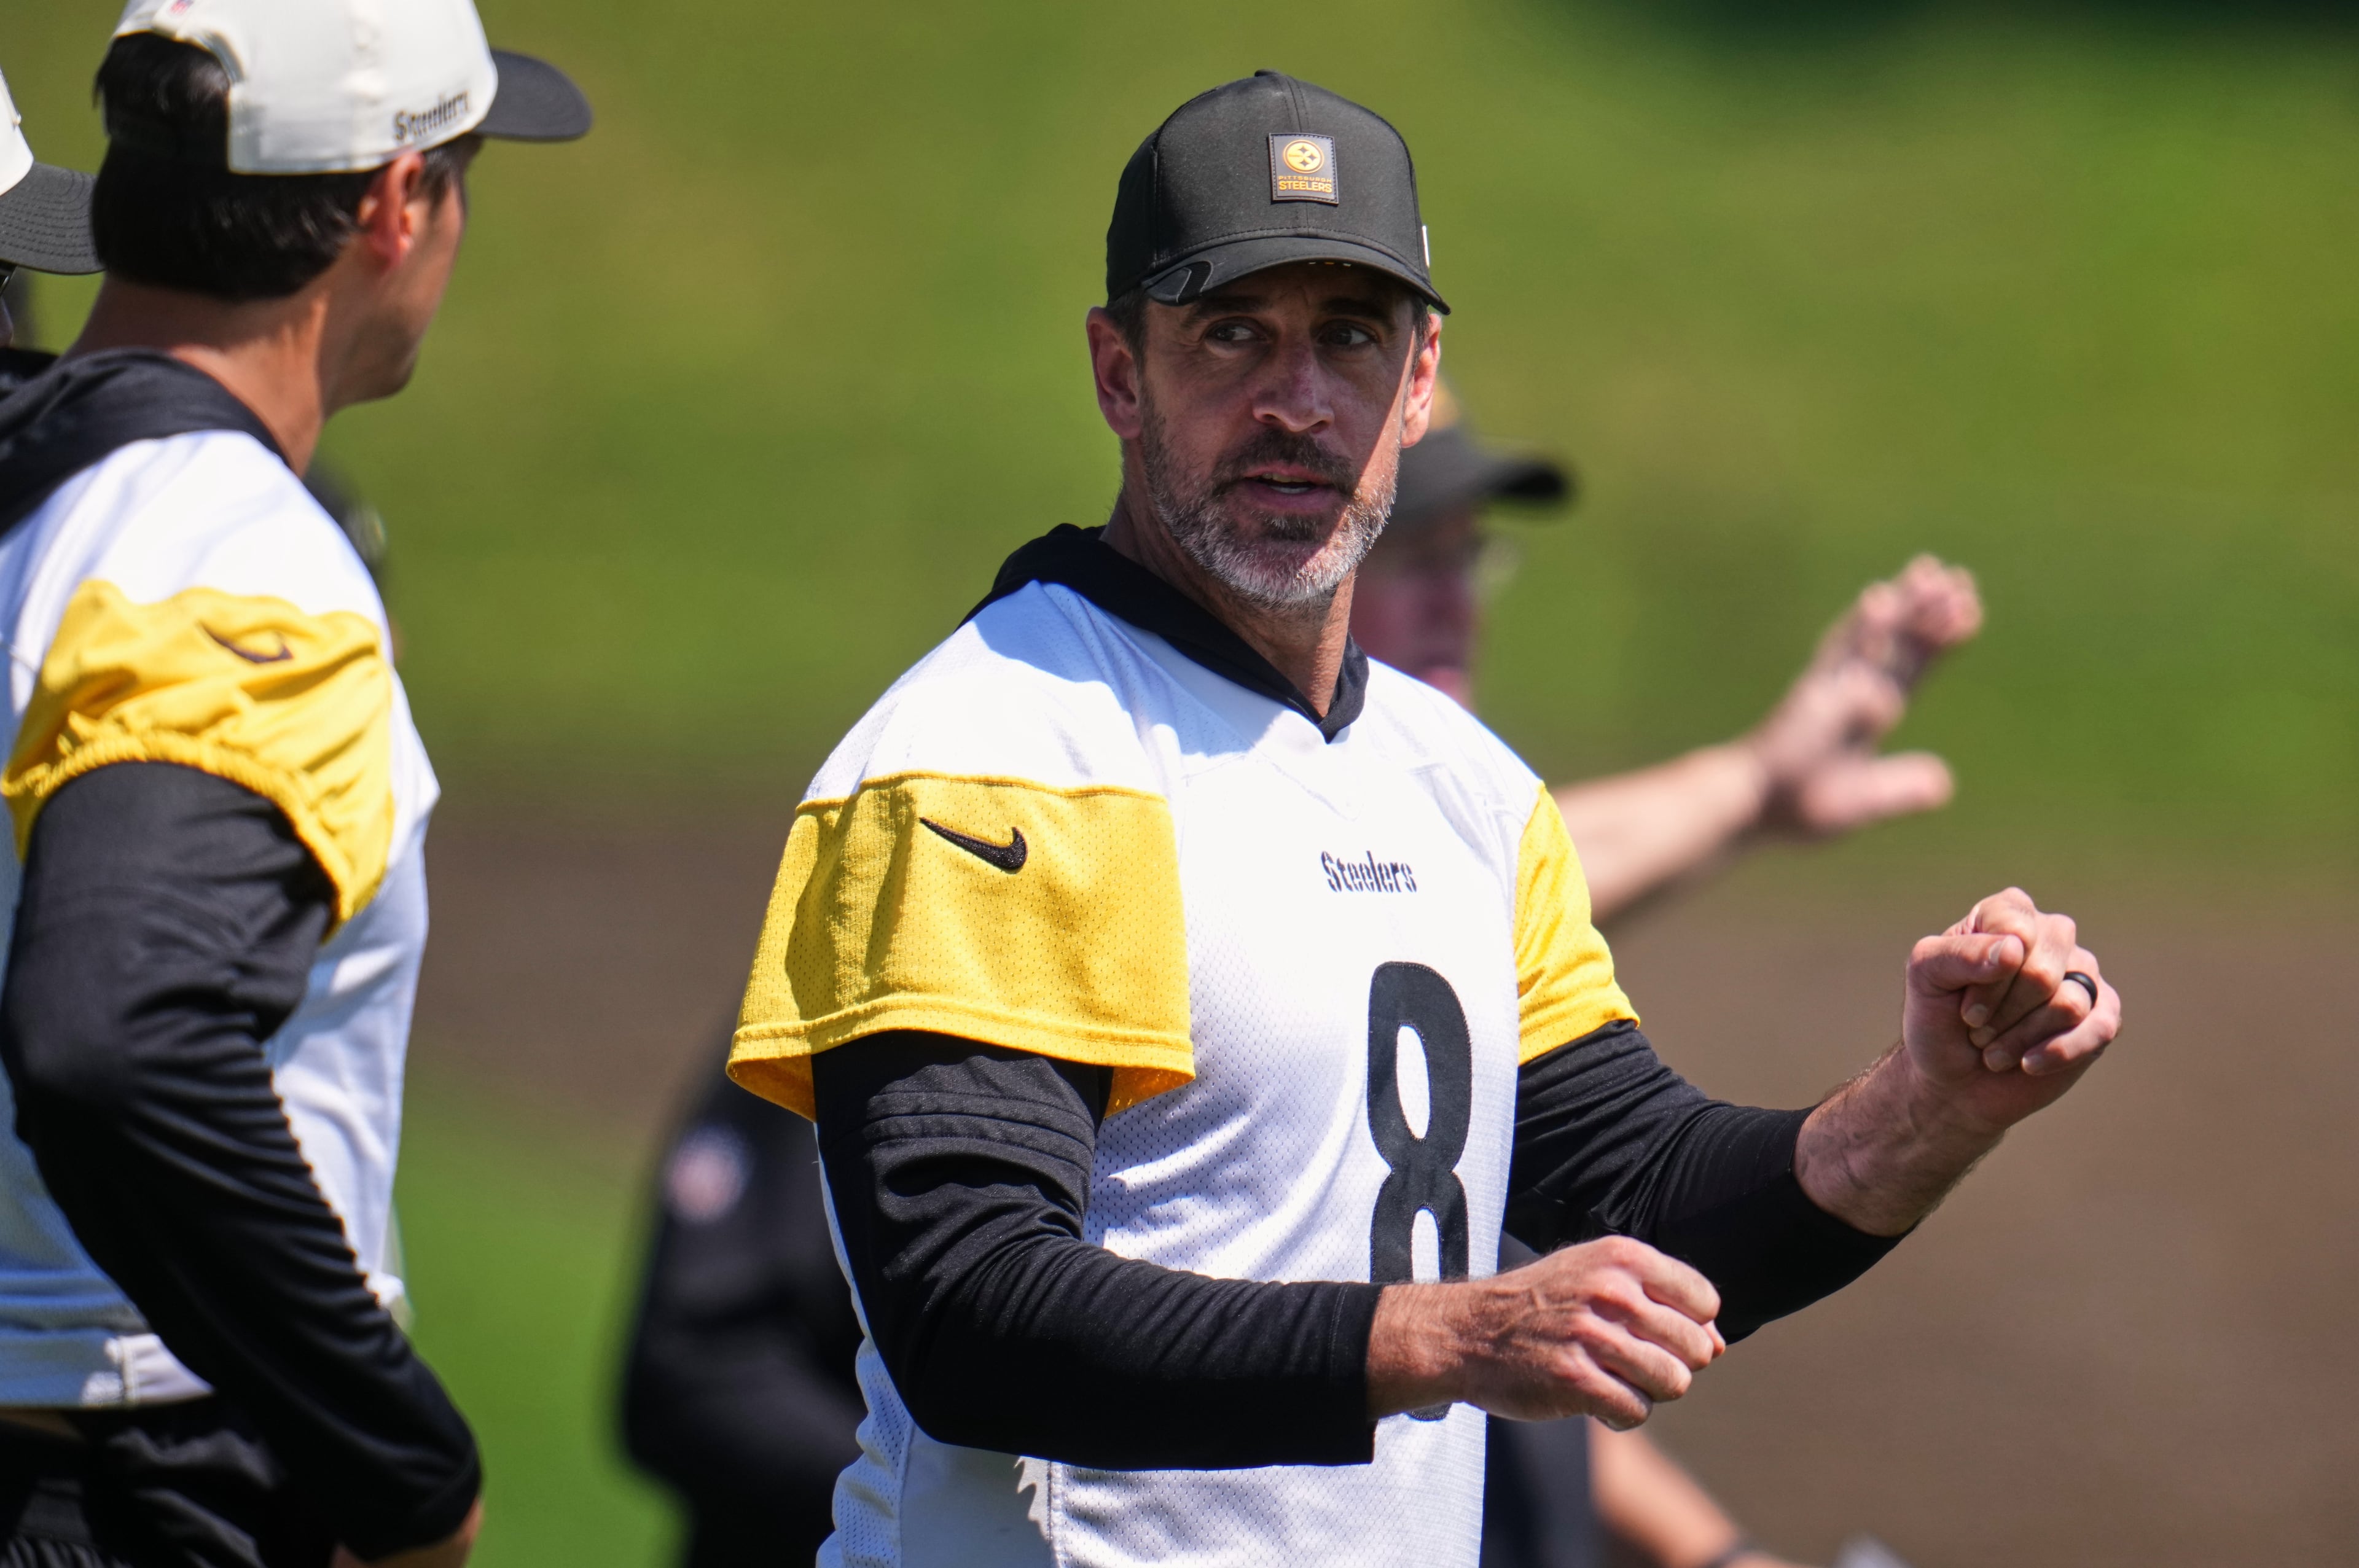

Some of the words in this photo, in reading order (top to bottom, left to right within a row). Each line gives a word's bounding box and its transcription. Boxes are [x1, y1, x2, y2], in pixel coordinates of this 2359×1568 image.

[1278, 181, 1332, 193] STEELERS
[1321, 850, 1417, 893] Steelers
[1367, 961, 1472, 1421] 8
